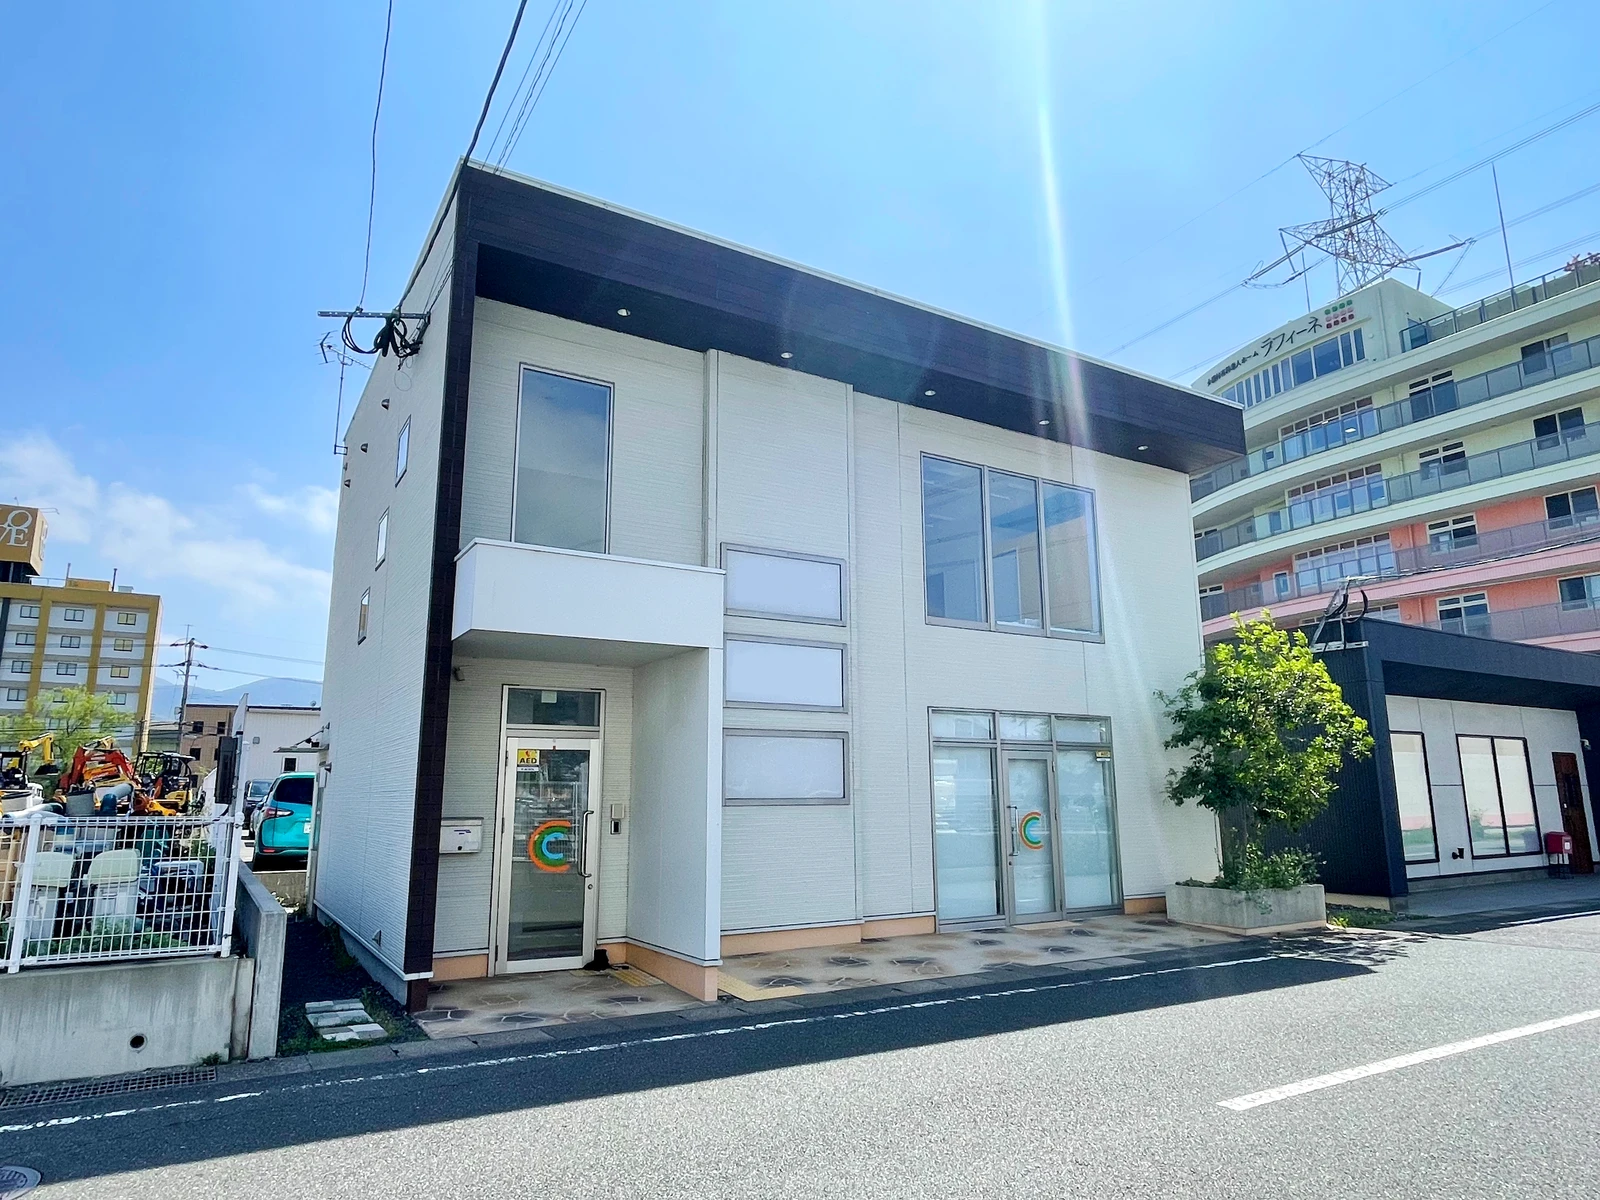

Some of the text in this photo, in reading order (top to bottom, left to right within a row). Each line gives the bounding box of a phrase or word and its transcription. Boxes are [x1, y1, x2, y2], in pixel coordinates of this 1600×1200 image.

[1261, 316, 1323, 357] ラフィーネ
[0, 510, 33, 529] O
